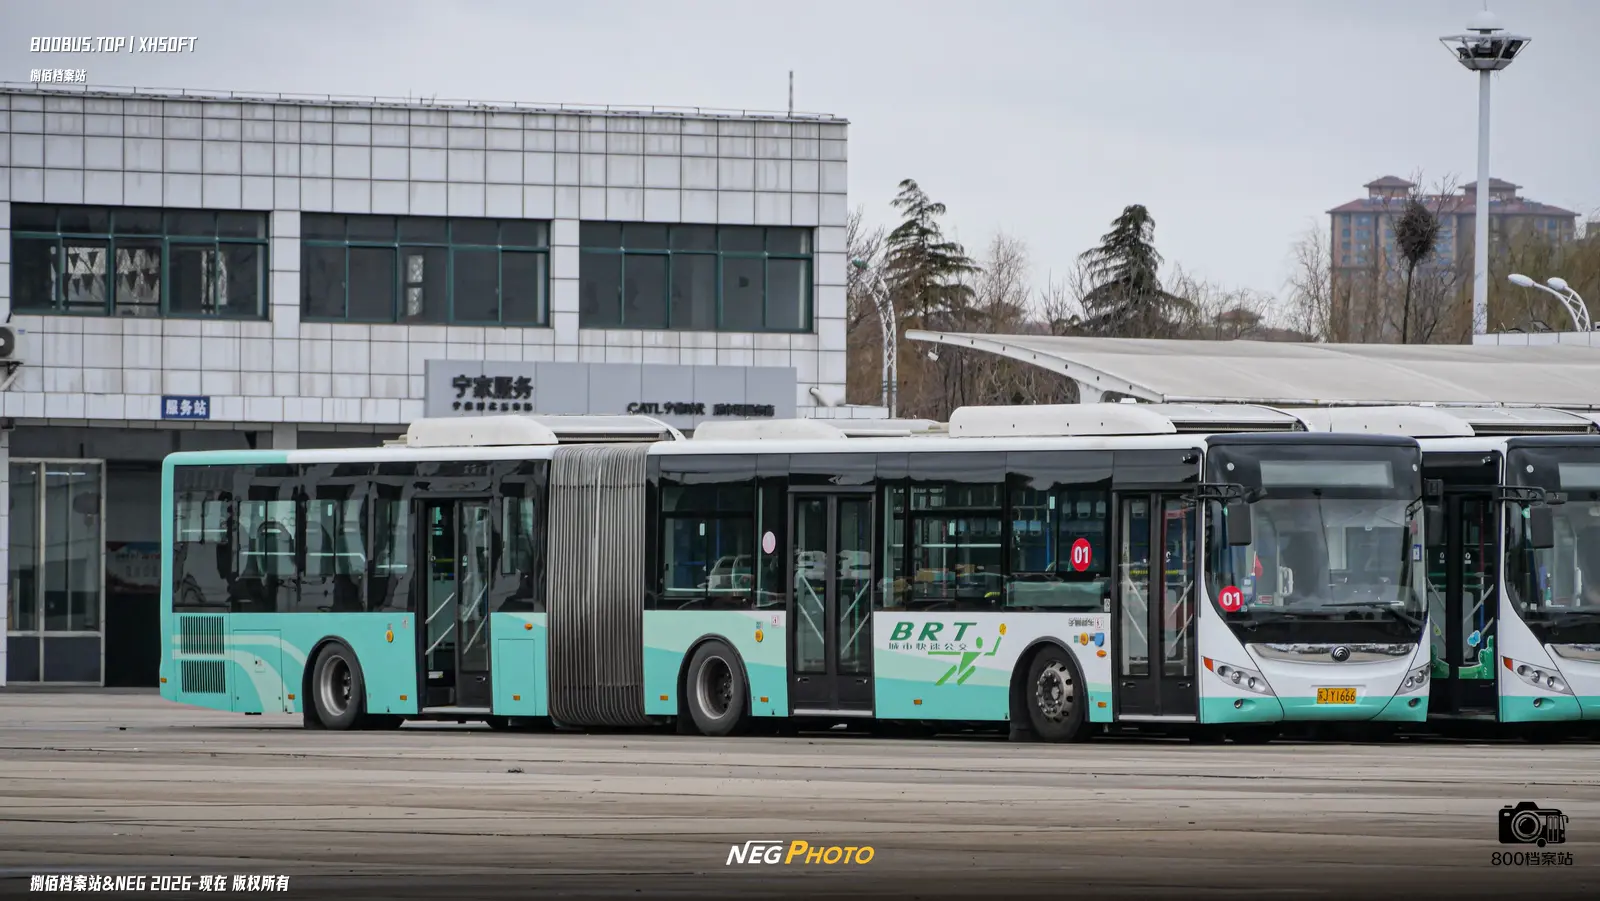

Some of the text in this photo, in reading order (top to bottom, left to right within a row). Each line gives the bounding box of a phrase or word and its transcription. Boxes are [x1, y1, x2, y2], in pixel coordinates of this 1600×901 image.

[165, 399, 206, 416] 服务站
[1074, 546, 1089, 564] 01
[1222, 591, 1241, 606] 01
[889, 621, 977, 641] BRT
[888, 642, 968, 651] 城市快速公交
